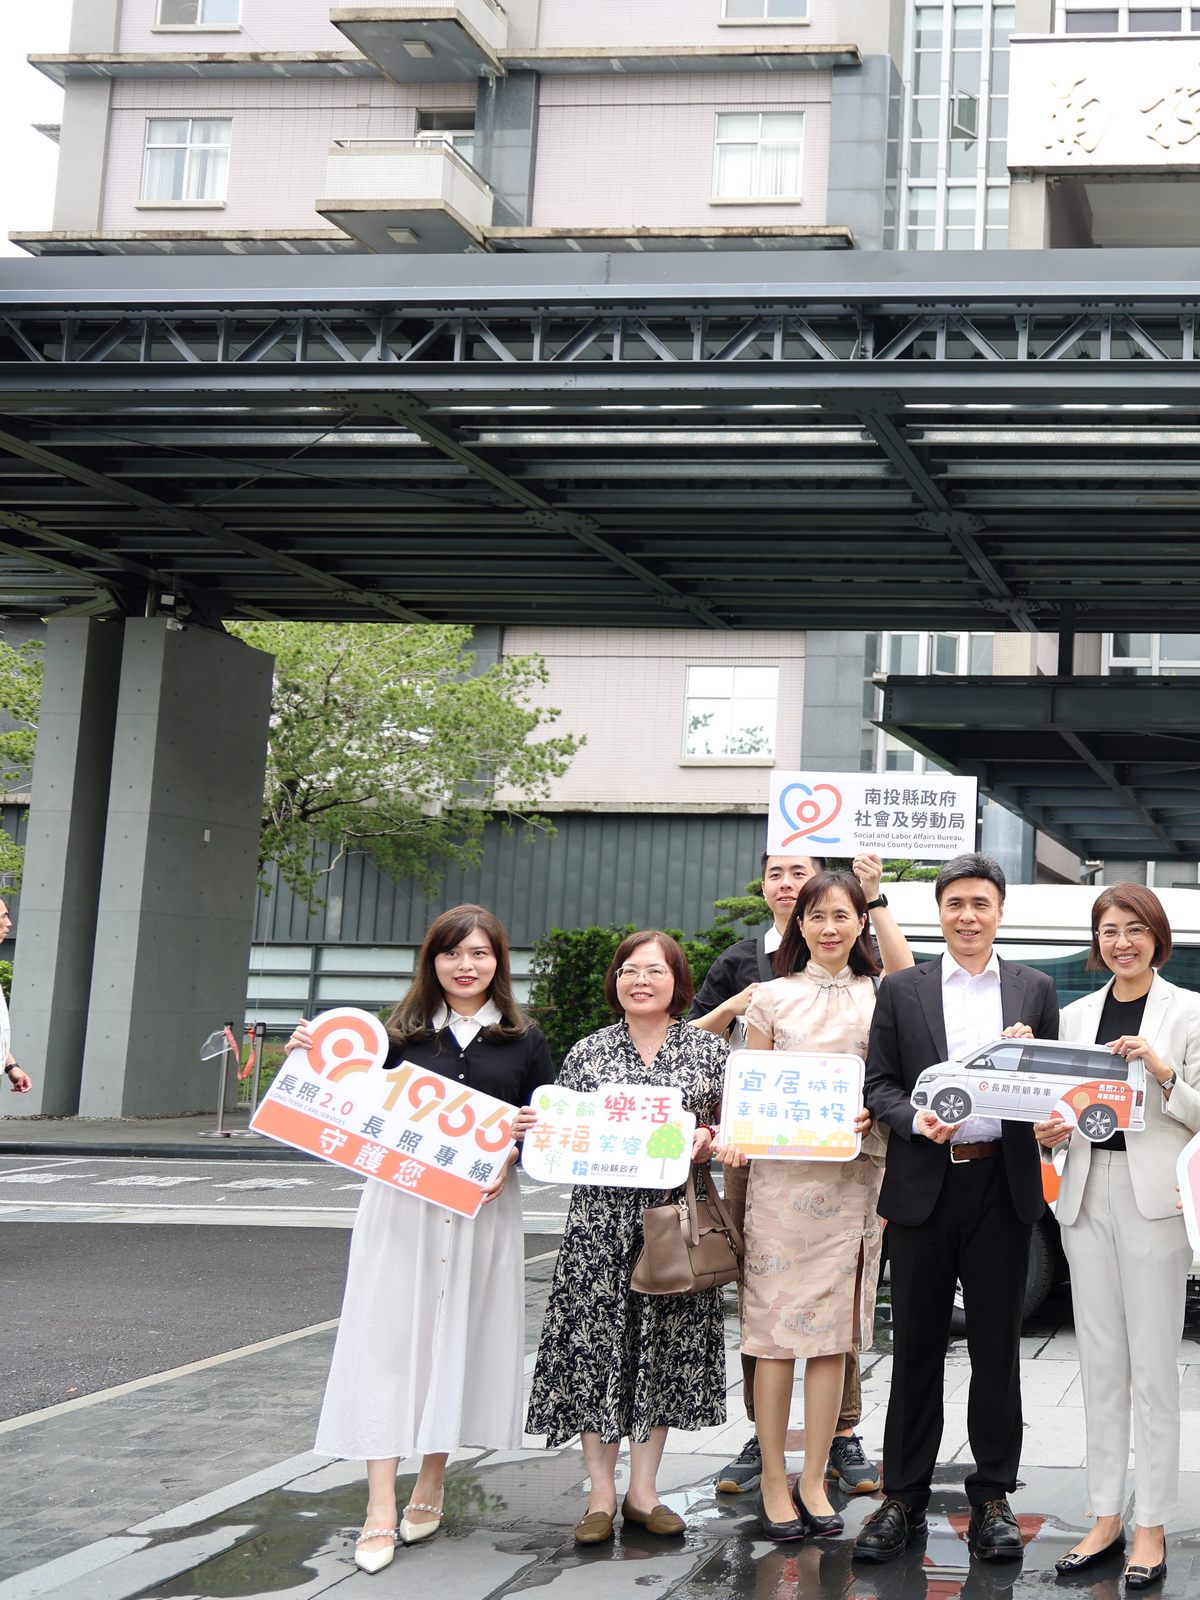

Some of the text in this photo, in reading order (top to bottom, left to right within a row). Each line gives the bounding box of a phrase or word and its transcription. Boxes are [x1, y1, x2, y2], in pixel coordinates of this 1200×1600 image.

[864, 788, 957, 807] 南投縣政府
[854, 810, 965, 830] 社會及勞動局
[853, 831, 875, 840] Social
[877, 832, 889, 840] and
[913, 833, 936, 841] Affairs
[937, 834, 965, 842] Bureau,
[887, 841, 912, 850] County
[913, 842, 958, 850] Government
[991, 1083, 1052, 1097] 長期照顧專車
[270, 1091, 345, 1126] LONG TERM CARE SERVICES
[382, 1065, 512, 1153] 1966
[319, 1129, 426, 1188] 守護您
[361, 1115, 494, 1184] 長照專線
